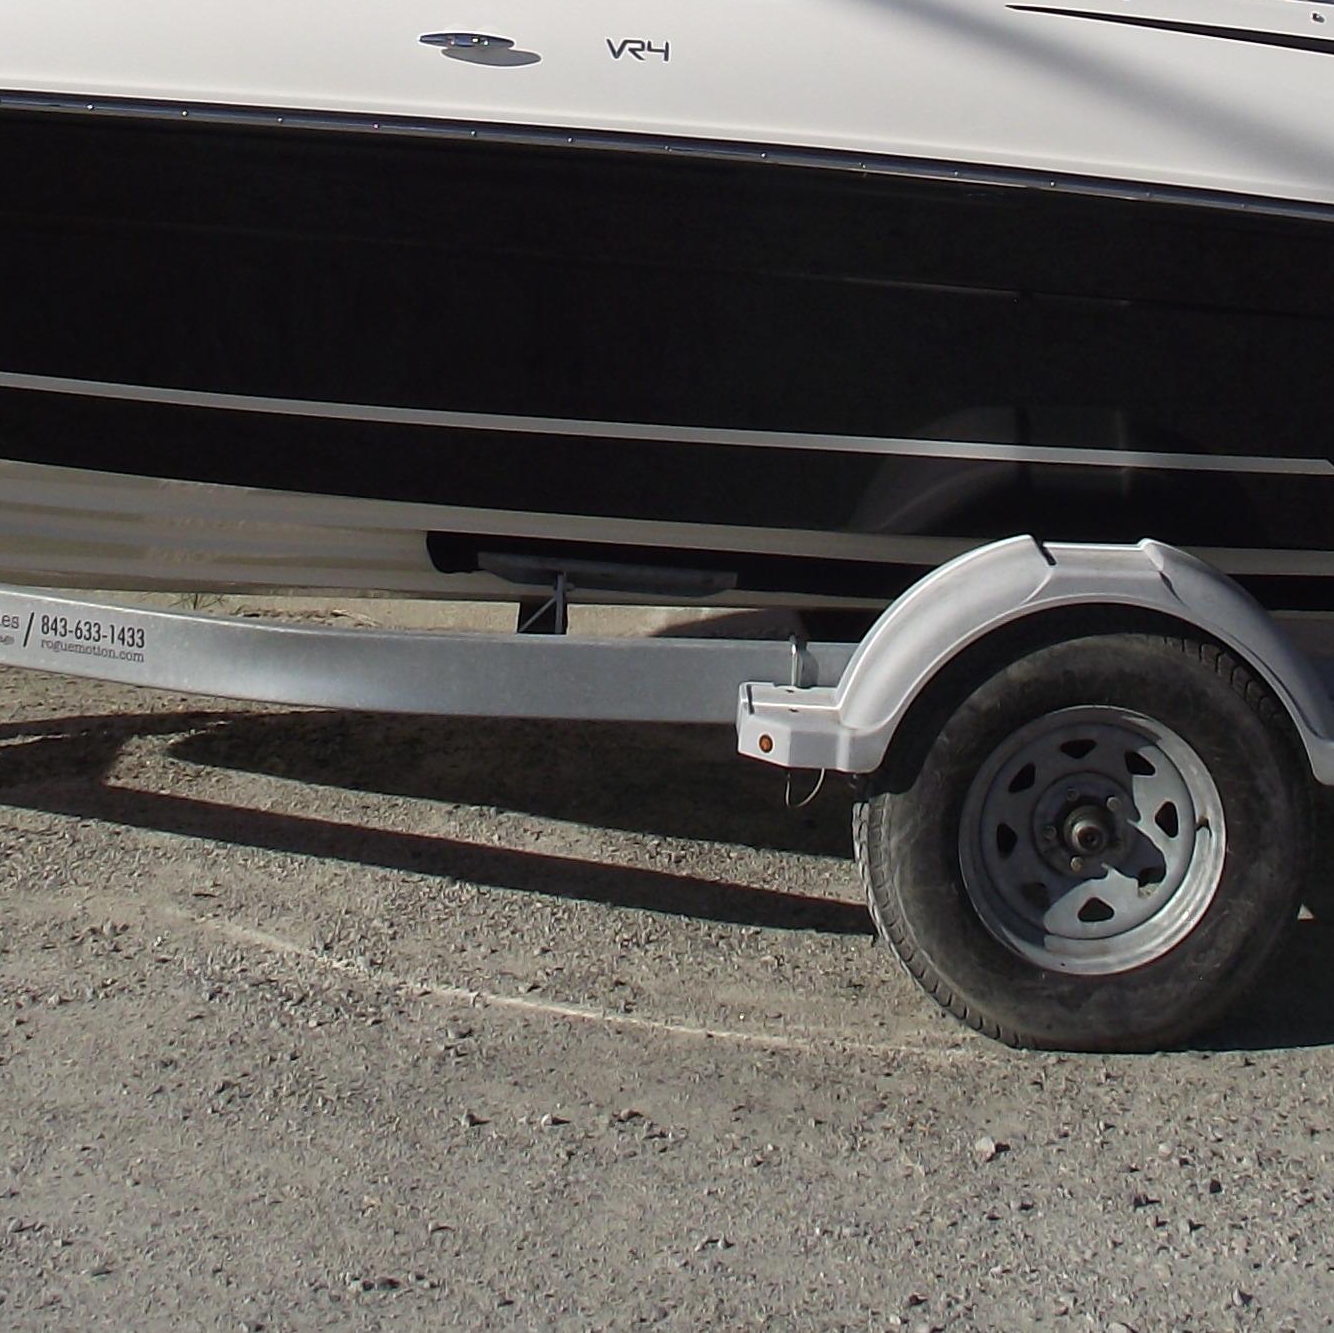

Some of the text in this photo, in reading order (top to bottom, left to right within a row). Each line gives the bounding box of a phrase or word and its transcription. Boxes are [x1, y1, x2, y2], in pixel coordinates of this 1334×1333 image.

[606, 38, 670, 62] VR4
[41, 615, 146, 649] 843-633-1433
[40, 639, 145, 663] roguemotion.com
